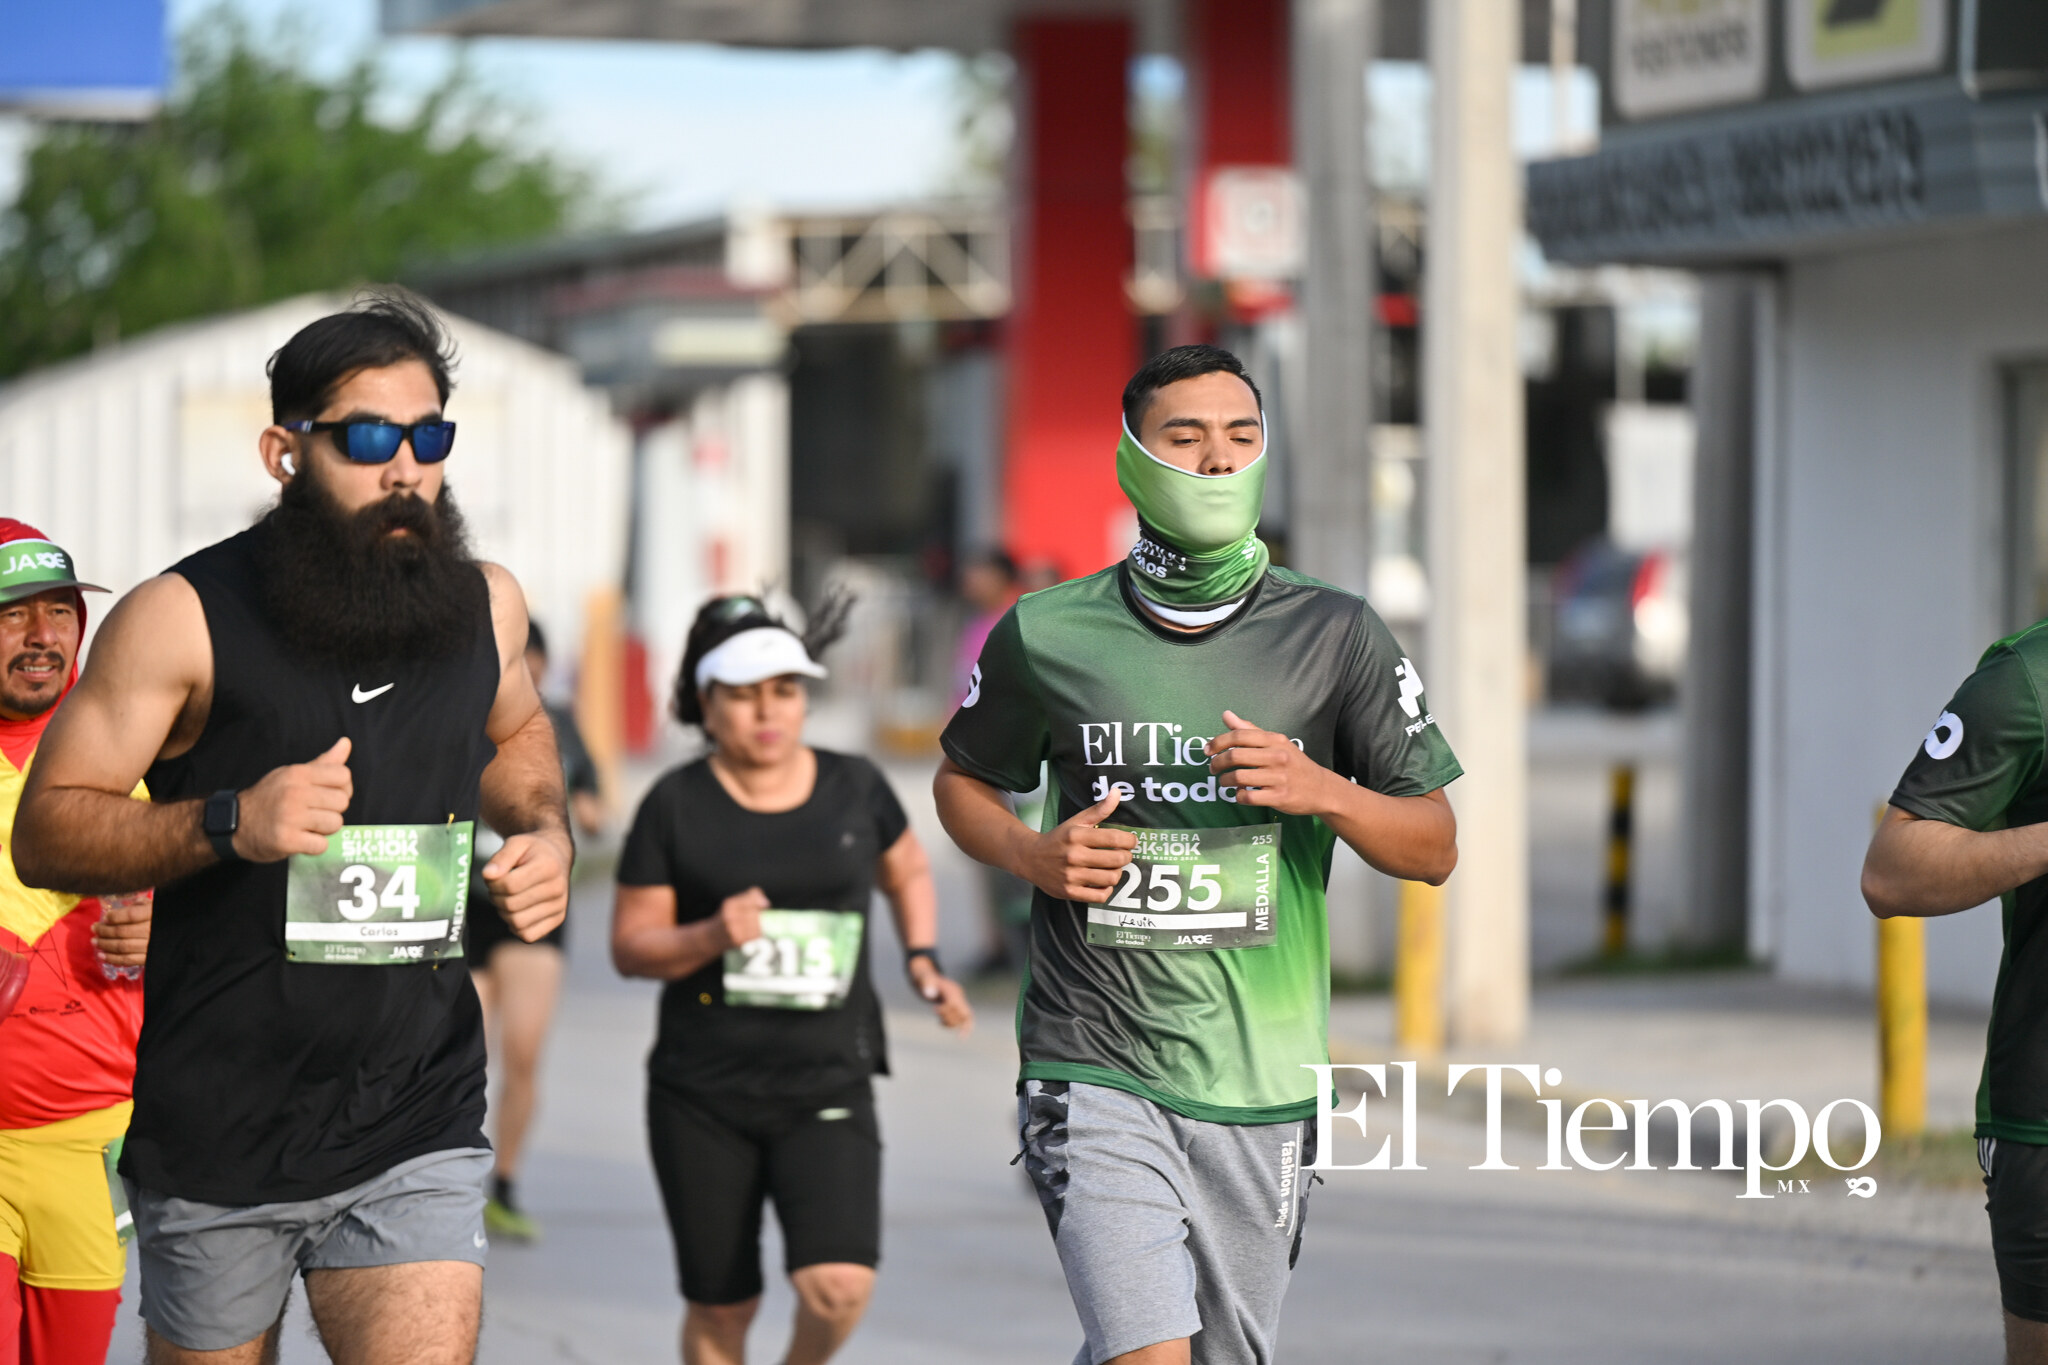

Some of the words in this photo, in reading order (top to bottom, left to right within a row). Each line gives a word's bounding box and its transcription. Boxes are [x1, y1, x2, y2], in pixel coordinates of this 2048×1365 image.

[1078, 721, 1127, 766] El
[1092, 775, 1136, 802] de
[1252, 835, 1272, 845] 255
[337, 864, 420, 922] 34
[449, 854, 468, 942] MEDALLA
[1108, 862, 1222, 911] 255
[1255, 853, 1270, 931] MEDALLA
[741, 937, 833, 976] 215
[1281, 1141, 1296, 1197] fashion
[1274, 1201, 1289, 1228] sport
